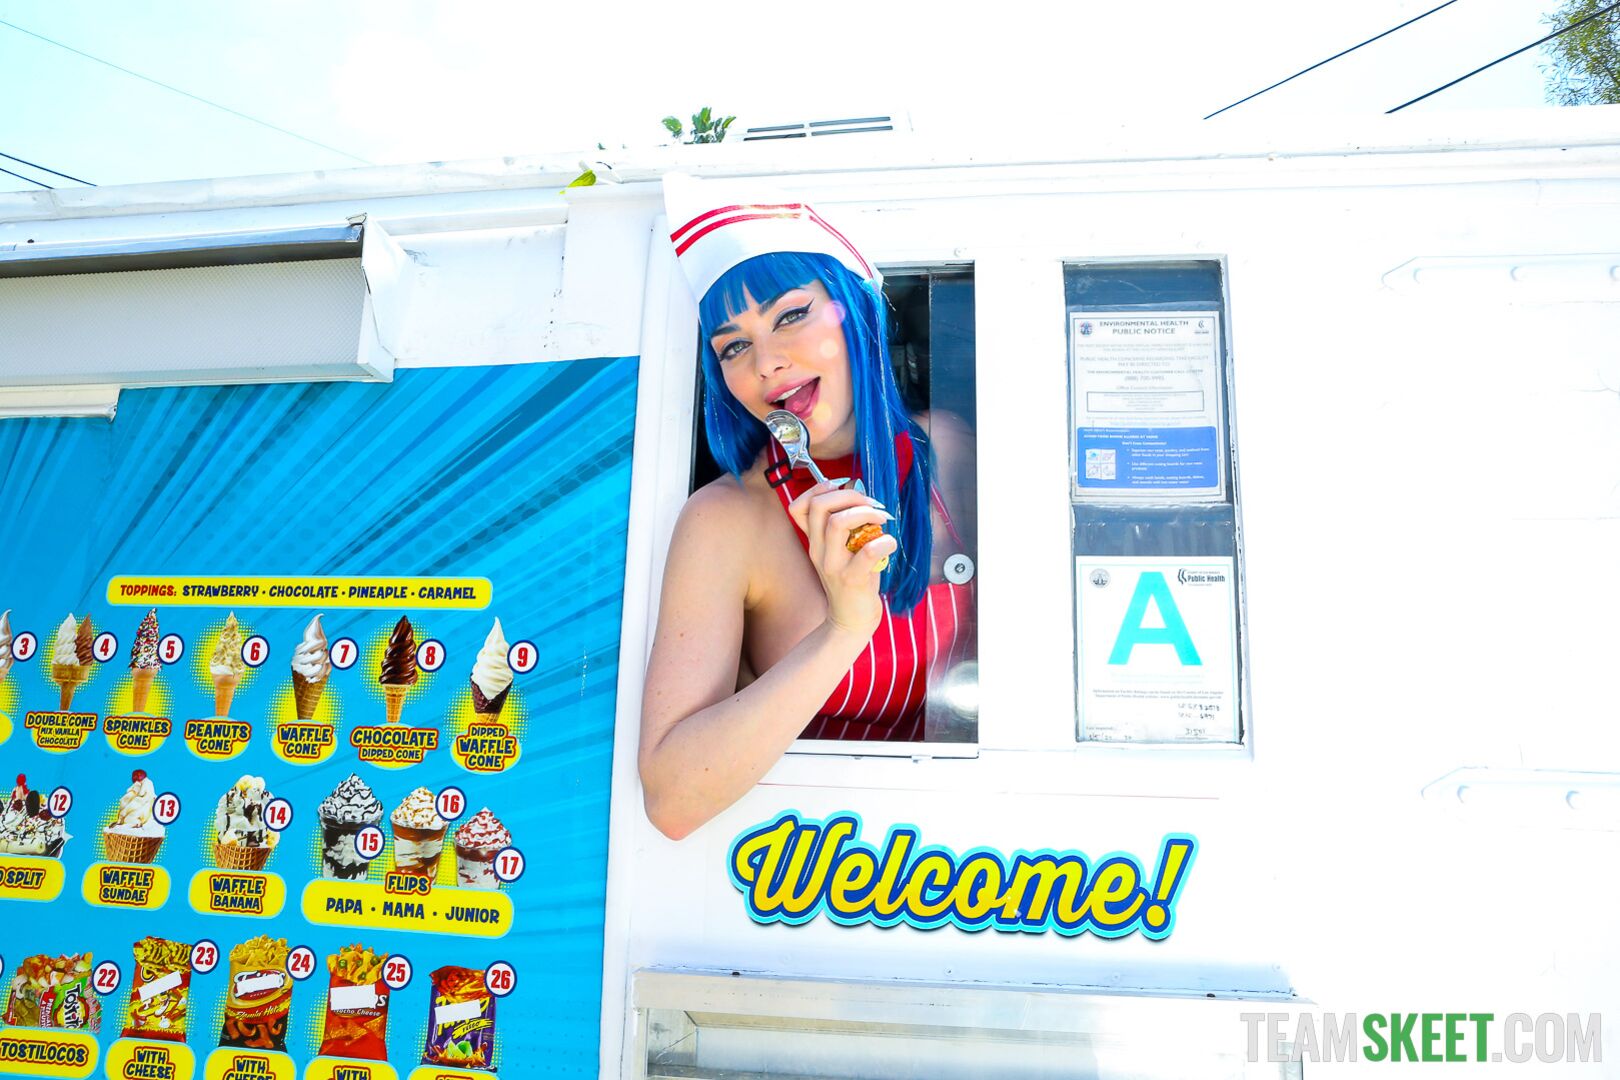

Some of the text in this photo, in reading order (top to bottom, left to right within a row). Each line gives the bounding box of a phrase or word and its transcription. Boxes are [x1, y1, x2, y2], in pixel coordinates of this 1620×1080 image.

[120, 584, 476, 600] TOPPINGS: STRAWBERRY CHOCOLATE PINEAPLE CARAMEL
[1107, 571, 1203, 666] A
[19, 638, 29, 656] 3
[99, 638, 110, 657] 4
[166, 640, 176, 659] 5
[250, 642, 261, 661] 6
[340, 644, 350, 663] 7
[425, 646, 436, 665] 8
[517, 648, 528, 667] 9
[27, 714, 94, 727] DOUBLE CONE
[106, 719, 169, 734] SPRINKLES
[40, 727, 80, 736] MIX VANILLA
[188, 723, 248, 739] PEANUTS
[280, 727, 332, 743] WAFFLE
[353, 730, 436, 747] CHOCOLATE
[471, 726, 505, 737] DIPPED
[39, 737, 78, 746] CHOCOLATE
[120, 734, 149, 747] CONE
[200, 738, 230, 751] CONE
[286, 742, 318, 755] CONE
[460, 738, 513, 754] WAFFLE
[361, 748, 421, 760] DIPPED CONE
[468, 754, 501, 767] CONE
[53, 794, 67, 811] 12
[159, 799, 176, 817] 13
[442, 794, 460, 813] 16
[269, 806, 286, 824] 14
[360, 833, 378, 852] 15
[501, 856, 519, 875] 17
[733, 816, 1194, 931] Welcome!
[6, 871, 44, 885] SPLIT
[103, 871, 151, 887] WAFFLE
[212, 878, 263, 894] WAFFLE
[387, 875, 428, 892] FLIPS
[102, 887, 145, 902] SUNDAE
[213, 896, 260, 910] BANANA
[326, 897, 499, 924] PAPA MAMA JUNIOR
[195, 946, 215, 965] 23
[291, 953, 310, 973] 24
[97, 968, 116, 988] 22
[386, 962, 405, 983] 25
[490, 970, 511, 990] 26
[1, 1042, 85, 1063] TOSTILOCOS
[136, 1050, 166, 1064] WITH
[127, 1064, 172, 1079] CHEESE
[236, 1059, 265, 1074] WITH
